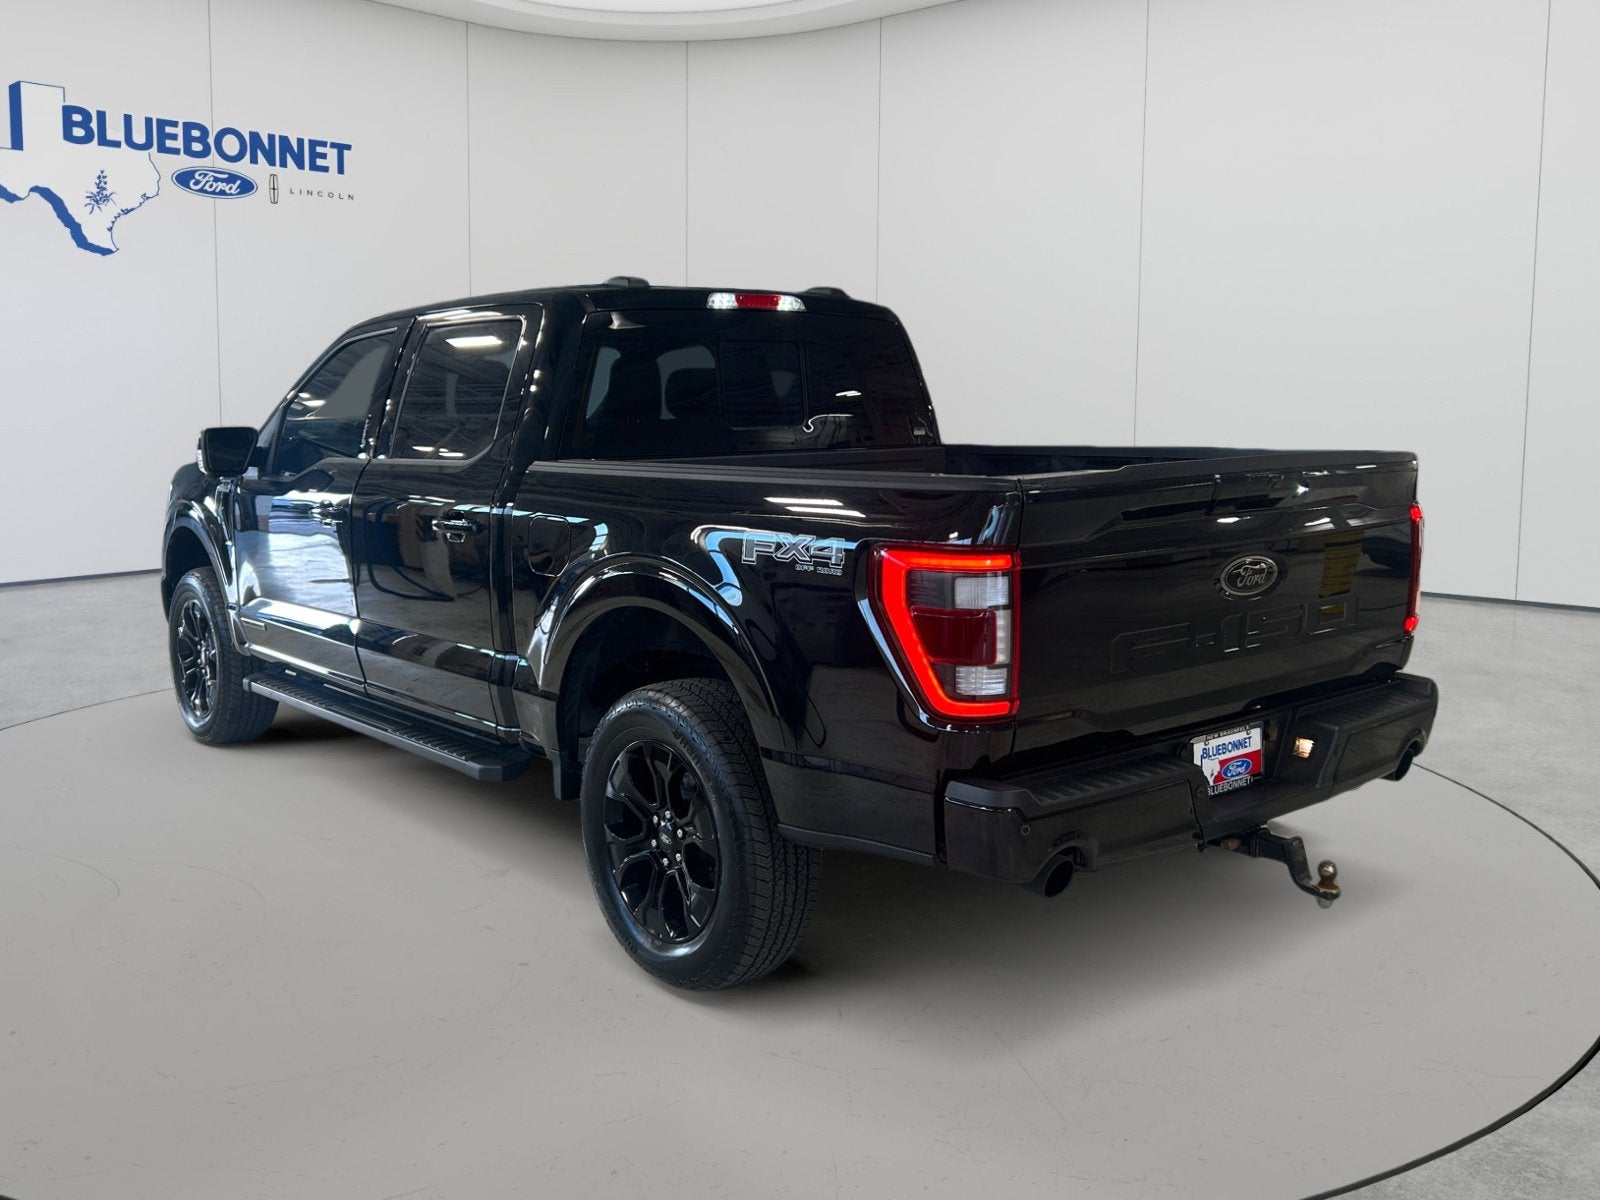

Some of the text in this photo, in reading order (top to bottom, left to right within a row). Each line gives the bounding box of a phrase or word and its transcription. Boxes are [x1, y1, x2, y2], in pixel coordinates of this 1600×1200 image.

[62, 104, 352, 175] BLUEBONNET
[189, 168, 241, 196] Ford
[288, 186, 355, 201] LINCOLN
[741, 530, 845, 568] FX4
[1233, 562, 1267, 588] Ford
[1110, 594, 1359, 673] F-150
[1202, 736, 1252, 760] BLUEBONNET
[1227, 762, 1246, 777] Ford
